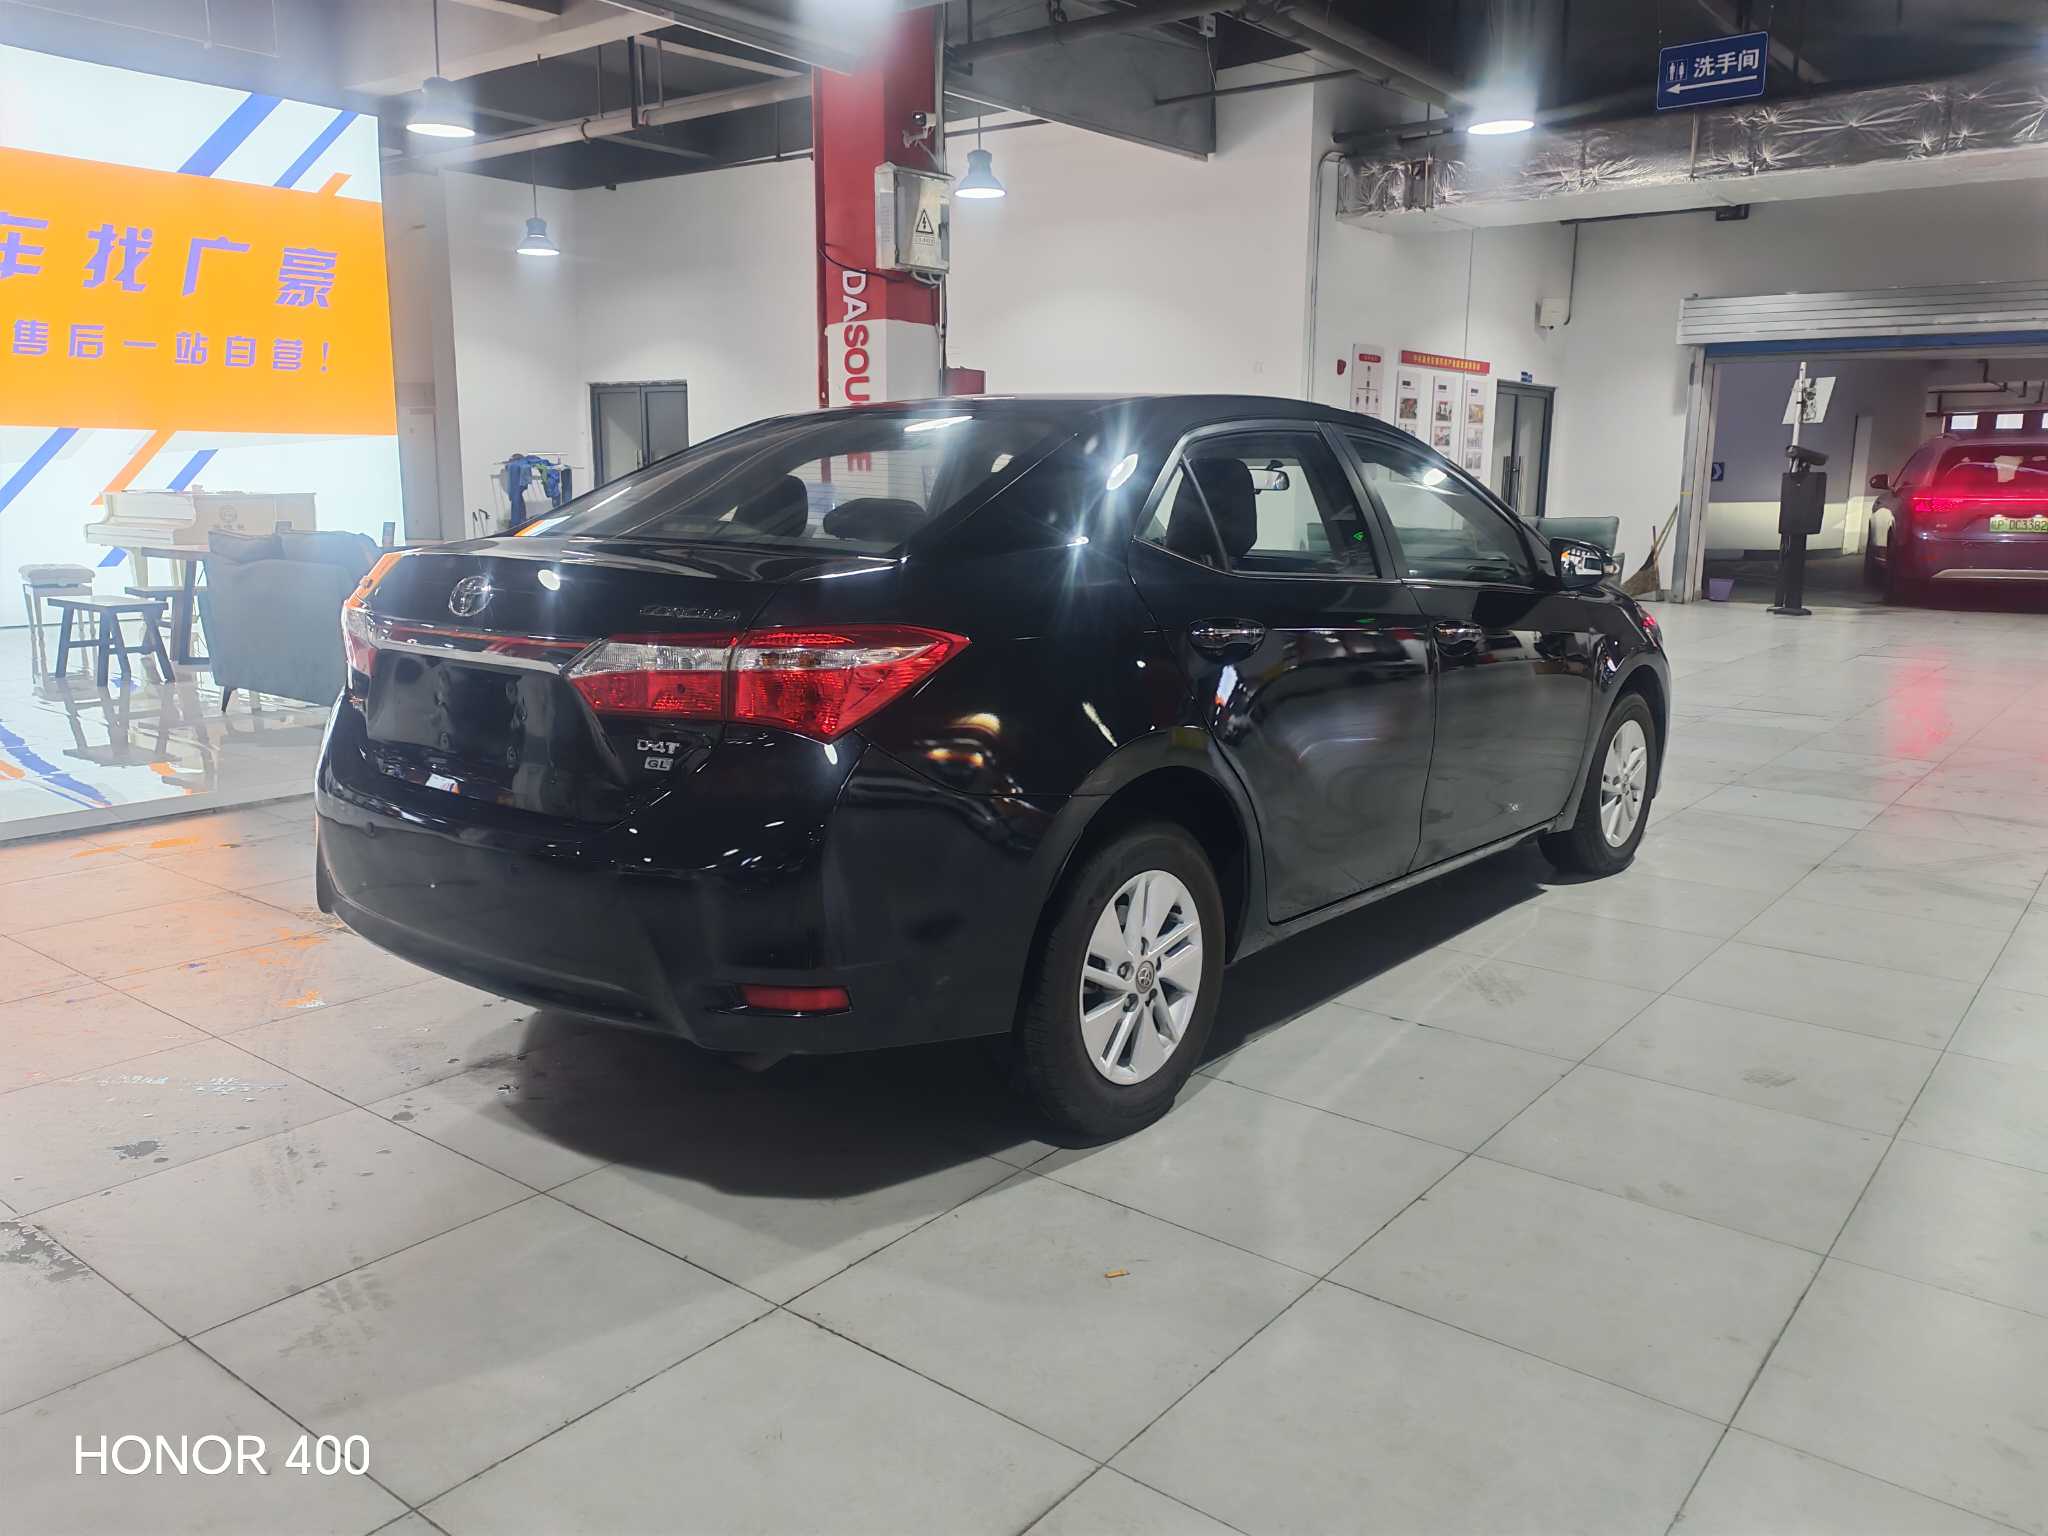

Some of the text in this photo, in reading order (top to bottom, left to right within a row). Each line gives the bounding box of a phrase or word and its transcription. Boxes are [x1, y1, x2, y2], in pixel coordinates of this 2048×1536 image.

[1694, 48, 1760, 78] 洗手间
[646, 758, 671, 770] GL
